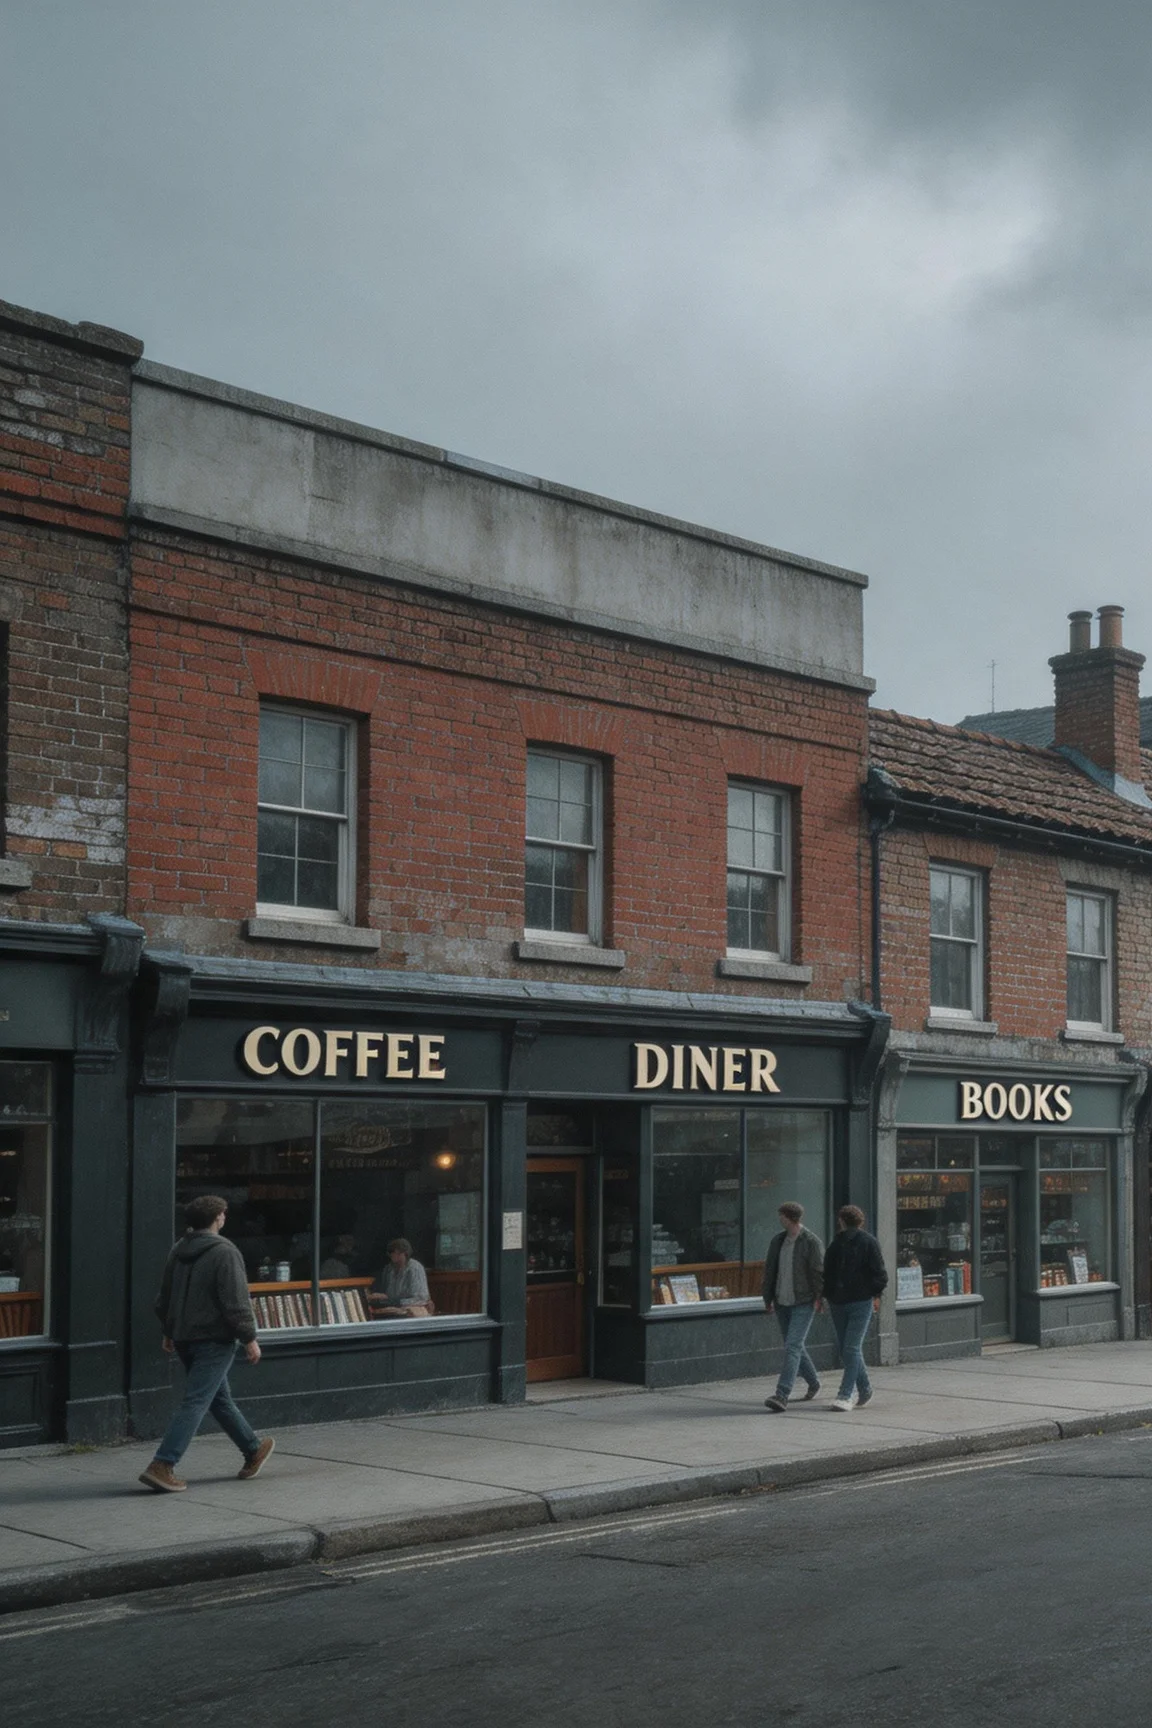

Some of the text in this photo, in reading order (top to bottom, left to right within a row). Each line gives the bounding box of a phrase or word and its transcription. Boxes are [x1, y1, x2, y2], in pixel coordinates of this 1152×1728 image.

[243, 1025, 447, 1080] COFFEE
[633, 1042, 782, 1093] DINER
[960, 1081, 1073, 1122] BOOKS
